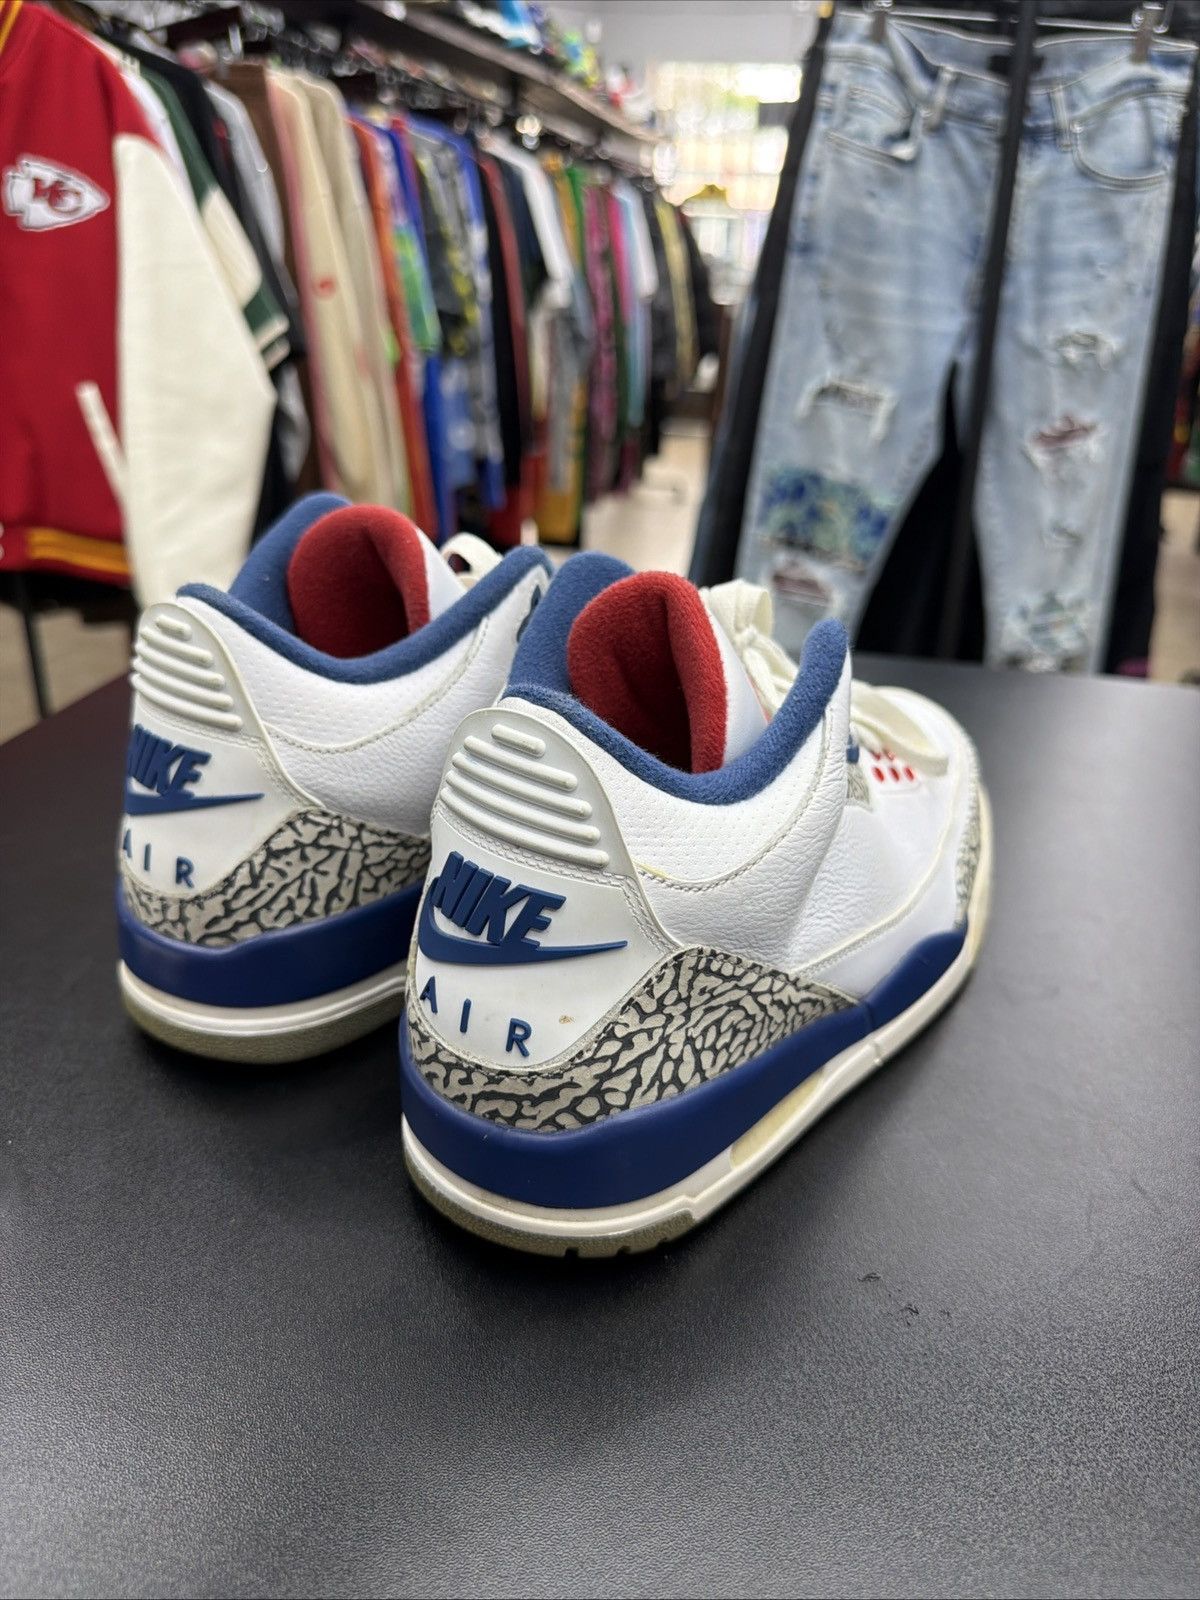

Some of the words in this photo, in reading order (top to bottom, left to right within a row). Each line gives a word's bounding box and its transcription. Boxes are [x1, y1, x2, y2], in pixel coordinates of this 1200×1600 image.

[123, 829, 195, 888] AIR
[431, 851, 567, 949] NIKE
[419, 976, 532, 1057] AIR
